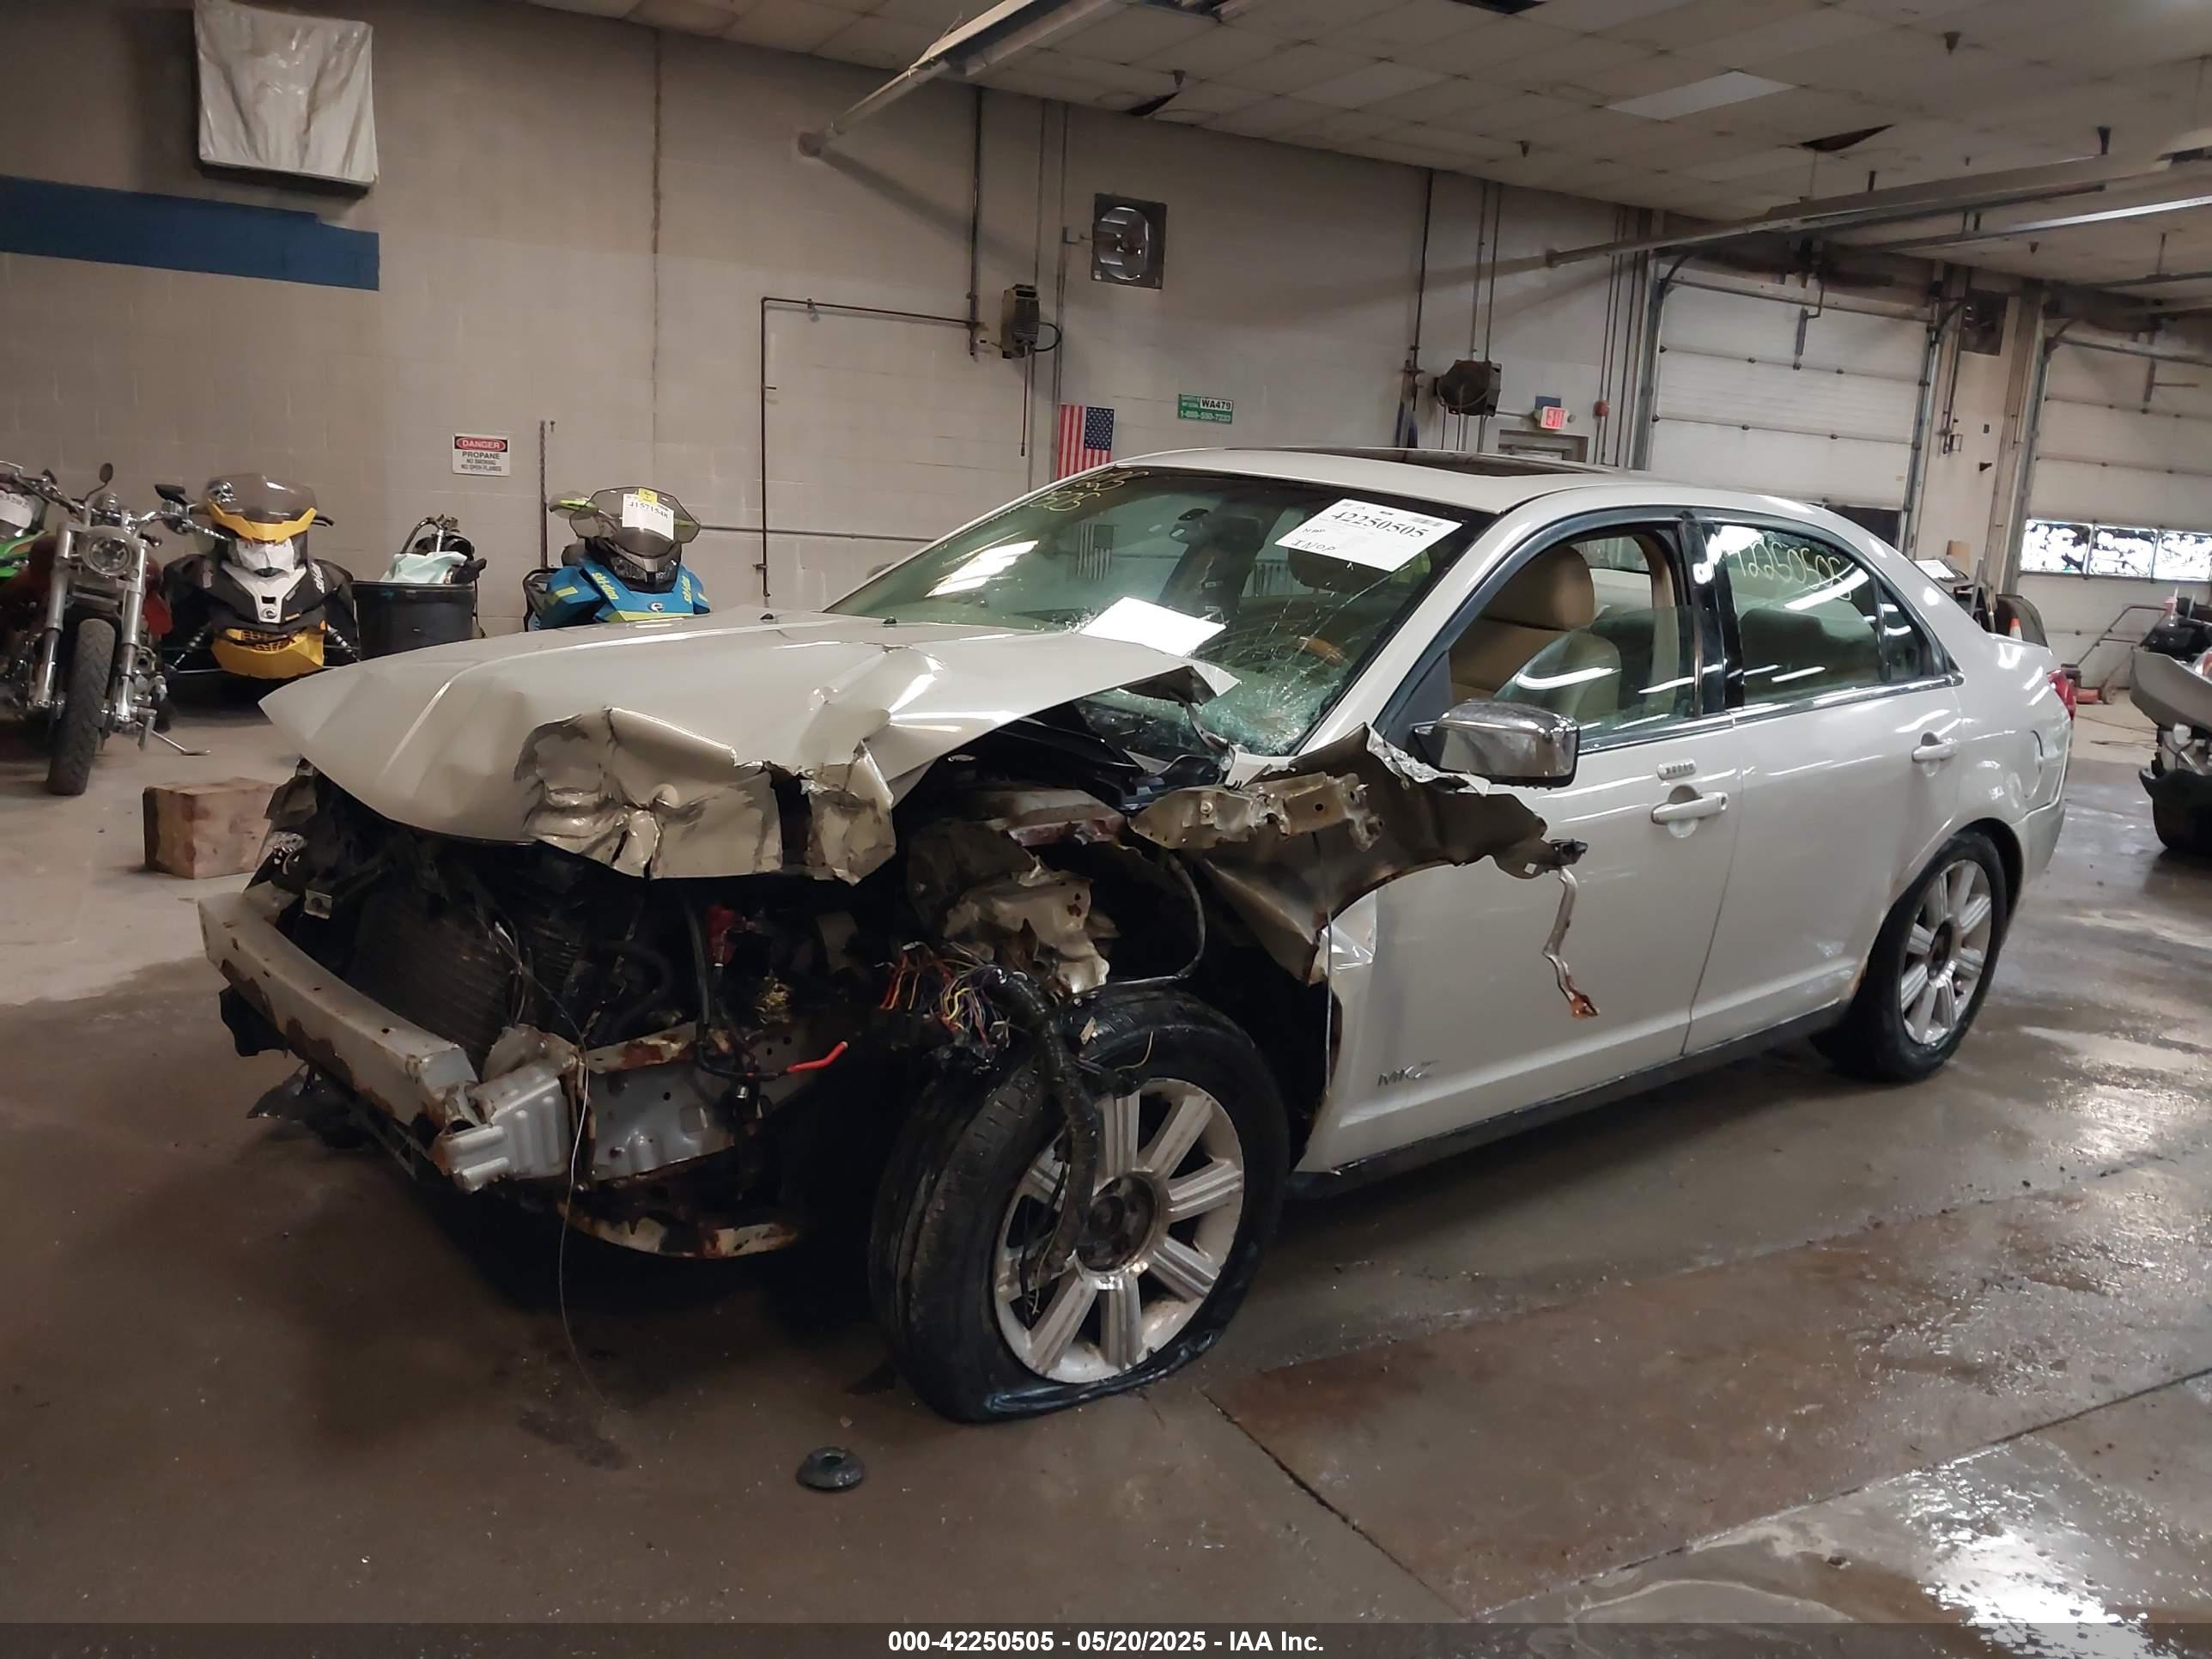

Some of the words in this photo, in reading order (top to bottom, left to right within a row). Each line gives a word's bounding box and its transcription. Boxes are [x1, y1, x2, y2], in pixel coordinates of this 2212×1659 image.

[1201, 399, 1231, 410] WA479
[462, 440, 500, 449] DANGER
[462, 451, 501, 459] PROPANE
[1331, 511, 1430, 538] 42250505
[1291, 538, 1337, 551] INOP
